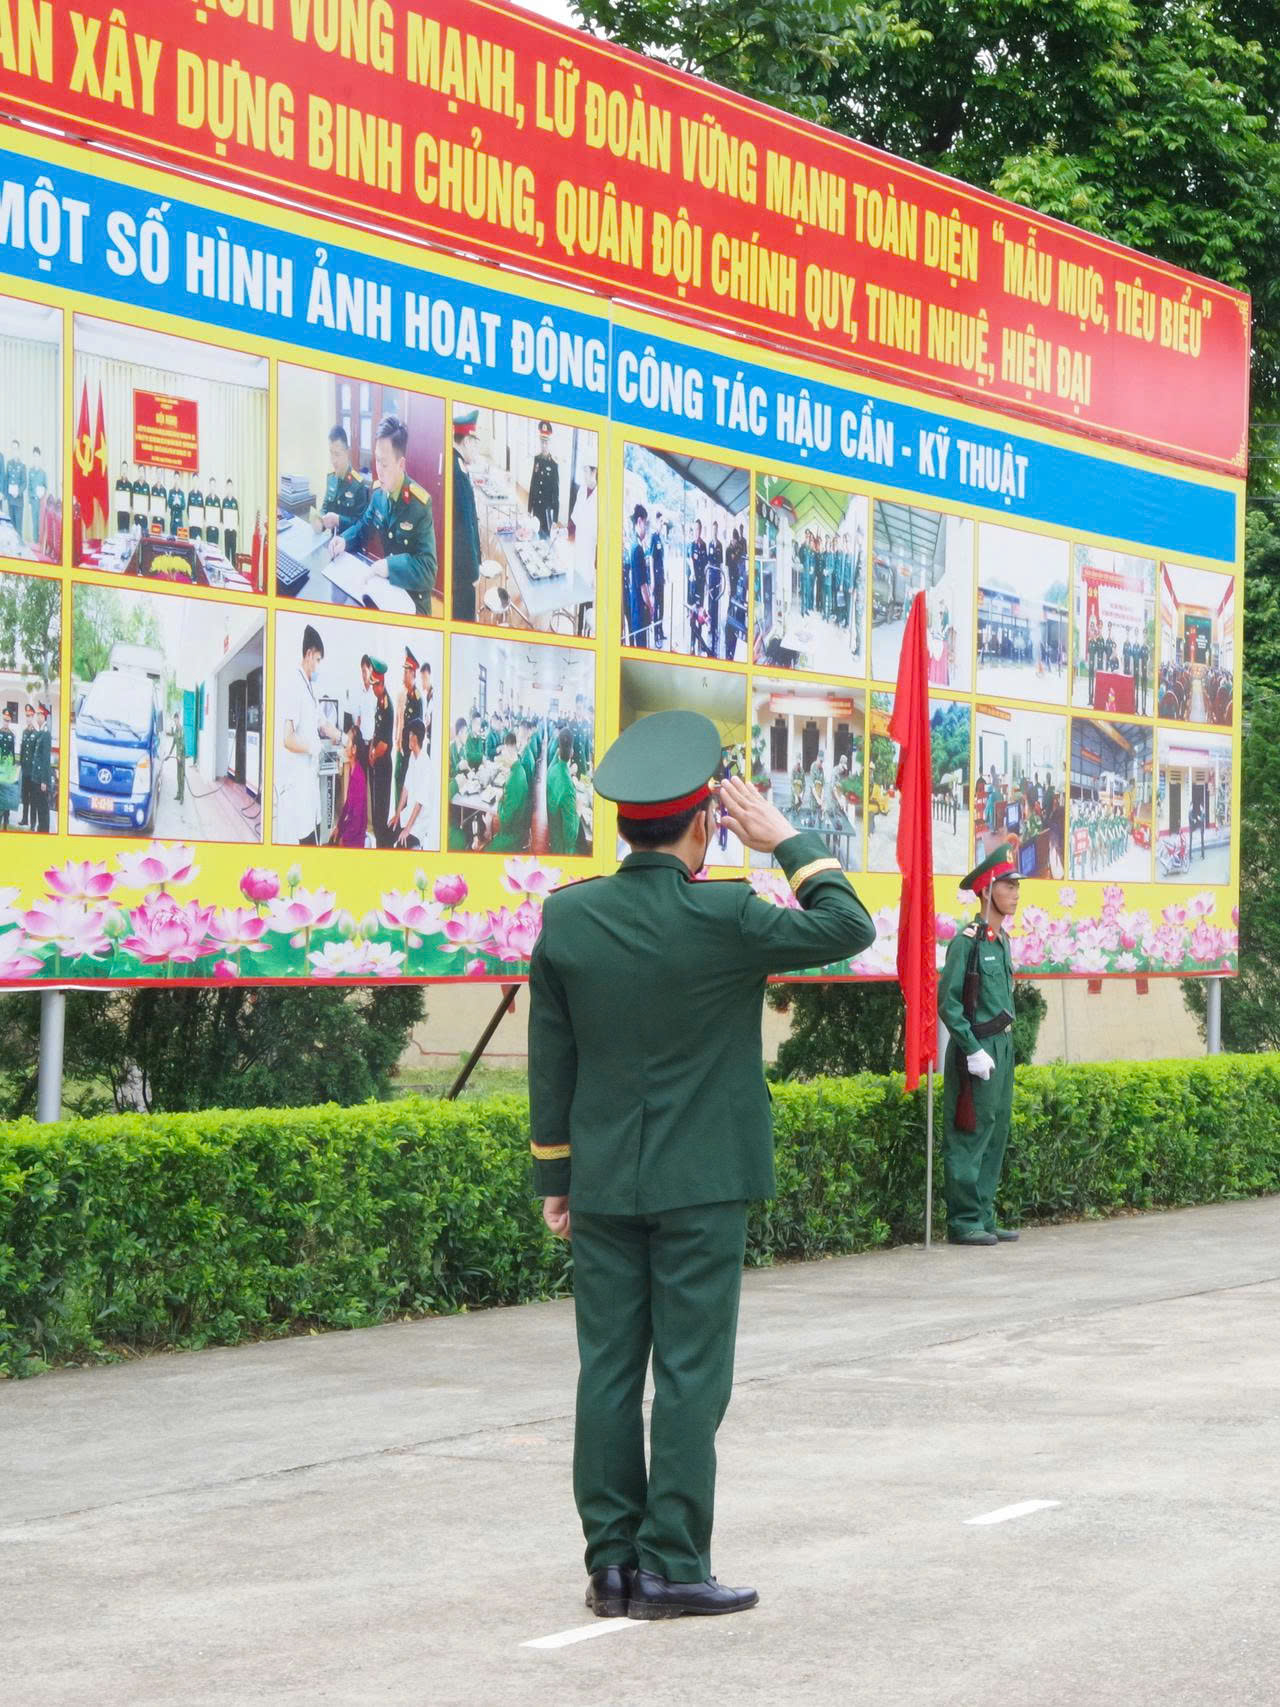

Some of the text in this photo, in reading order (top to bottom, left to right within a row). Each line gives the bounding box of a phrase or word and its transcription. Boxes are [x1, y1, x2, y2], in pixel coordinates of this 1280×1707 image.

[0, 175, 90, 272] MỘT
[106, 201, 172, 285] SỐ
[186, 227, 293, 318] HÌNH
[306, 247, 392, 343] ẢNH
[405, 291, 500, 375] HOẠT
[511, 316, 606, 393] ĐỘNG
[618, 346, 704, 421] CÔNG
[712, 371, 767, 436] TÁC
[776, 388, 832, 458] HẬU
[840, 399, 894, 467] CẦN
[919, 425, 951, 480] KỸ
[957, 439, 1029, 505] THUẬT
[69, 8, 163, 116] XÂY
[177, 48, 294, 161] DỰNG
[308, 94, 402, 195] BINH
[414, 127, 545, 247] CHỦNG,
[555, 181, 644, 270] QUÂN
[652, 207, 703, 298] ĐỘI
[711, 231, 797, 318] CHÍNH
[804, 264, 858, 343] QUY,
[866, 283, 922, 355] TINH
[928, 303, 995, 387] NHUỆ,
[1002, 323, 1051, 400] HIỆN
[1057, 345, 1092, 415] ĐẠI
[407, 11, 525, 130] MẠNH,
[536, 57, 580, 139] LỮ
[585, 81, 672, 174] ĐOÀN
[680, 112, 758, 205] VỮNG
[766, 150, 845, 237] MẠNH
[853, 183, 918, 261] TOÀN
[924, 208, 978, 288] DIỆN
[992, 220, 1053, 307] “MẪU
[1058, 259, 1110, 335] MỰC,
[1114, 276, 1156, 343] TIÊU
[1160, 285, 1212, 359] BIỂU”
